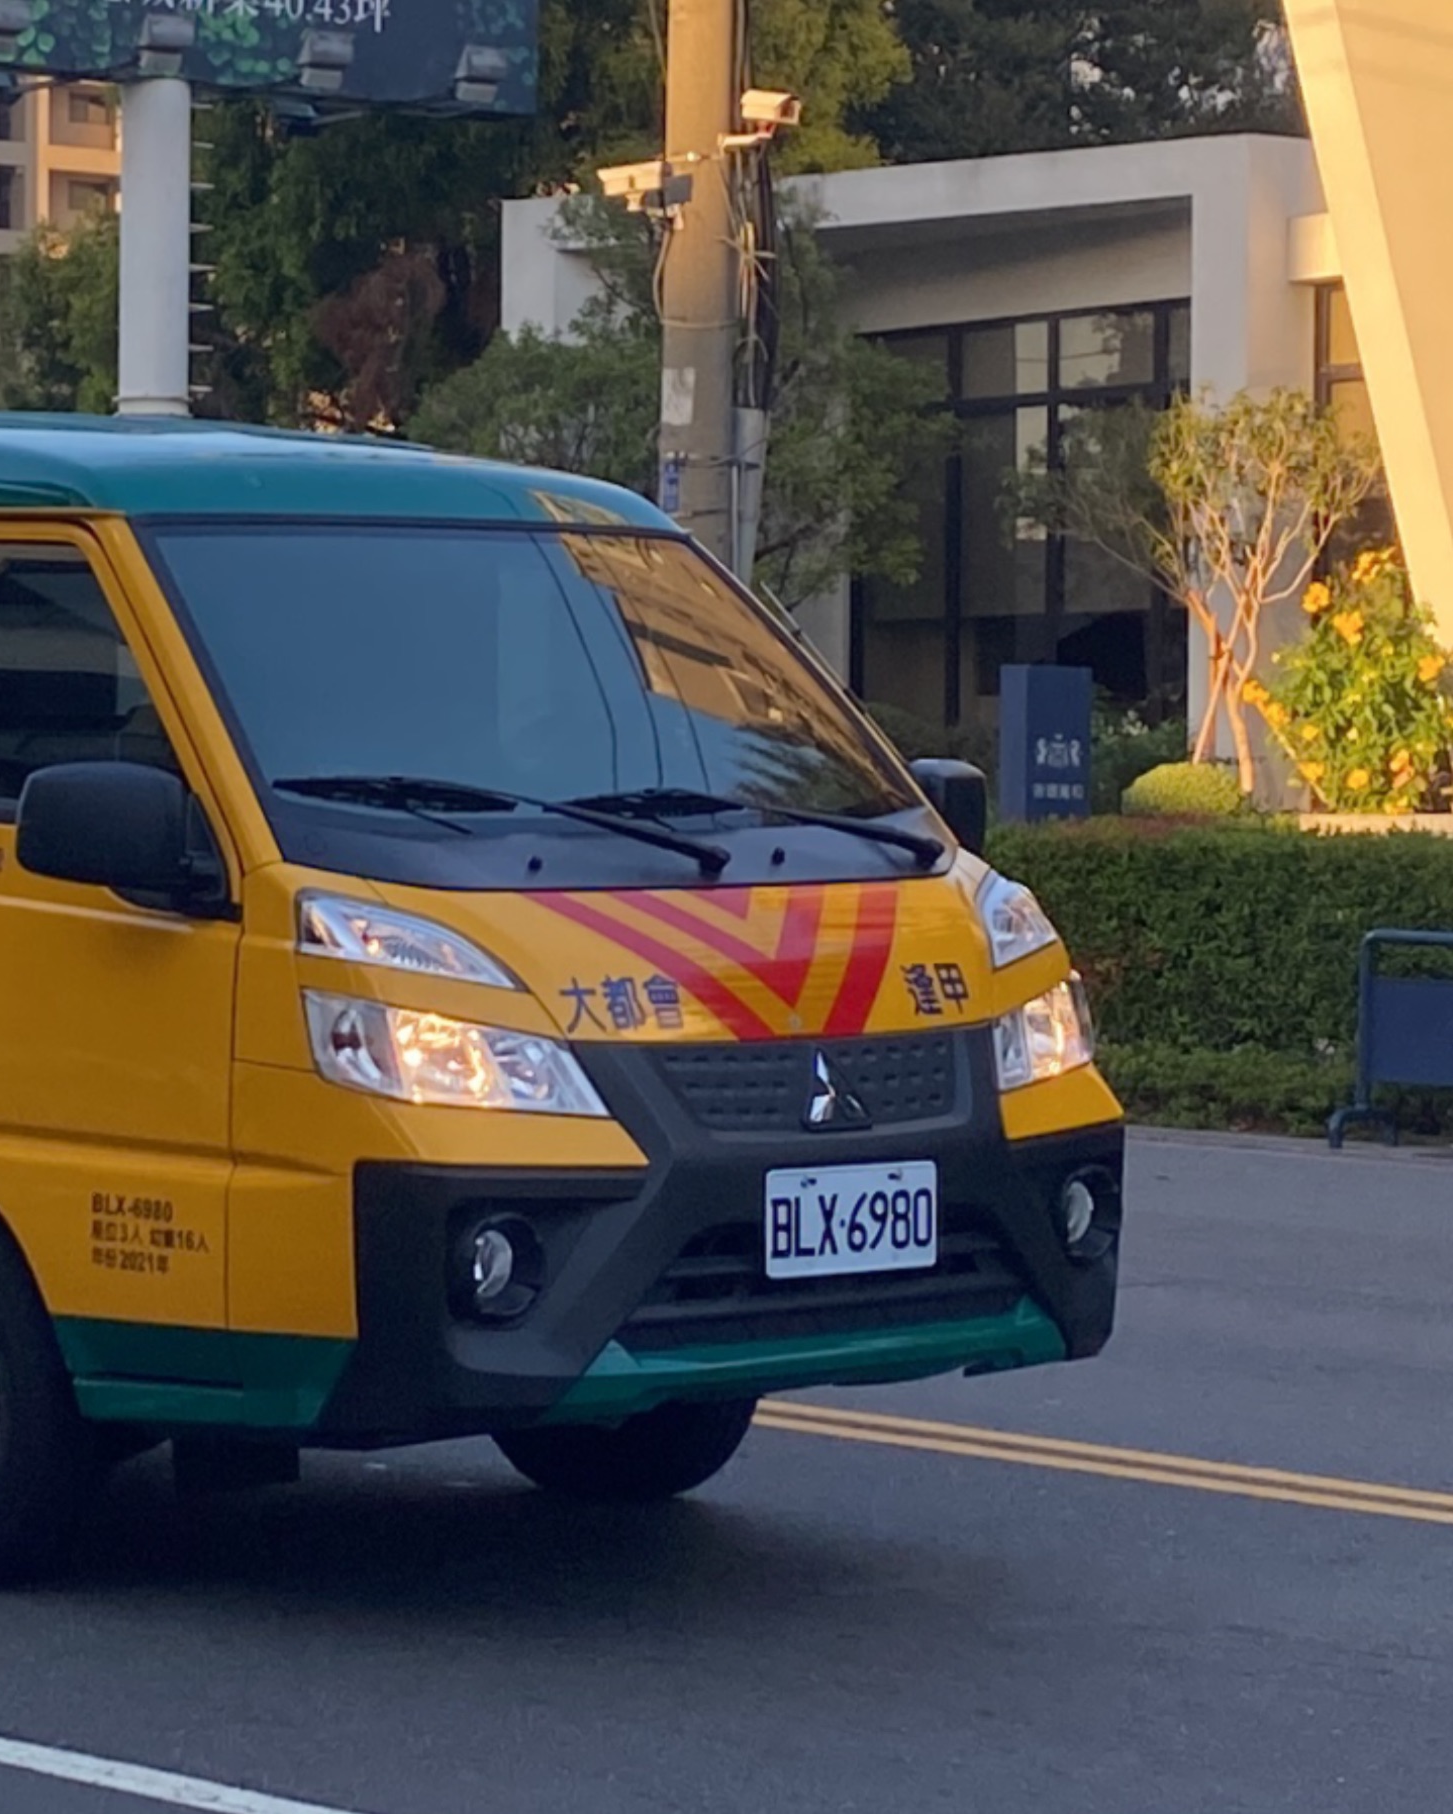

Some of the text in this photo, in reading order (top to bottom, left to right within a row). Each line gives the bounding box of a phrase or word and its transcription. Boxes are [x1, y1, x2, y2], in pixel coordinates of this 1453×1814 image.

[558, 962, 969, 1033] 大都會 逢甲
